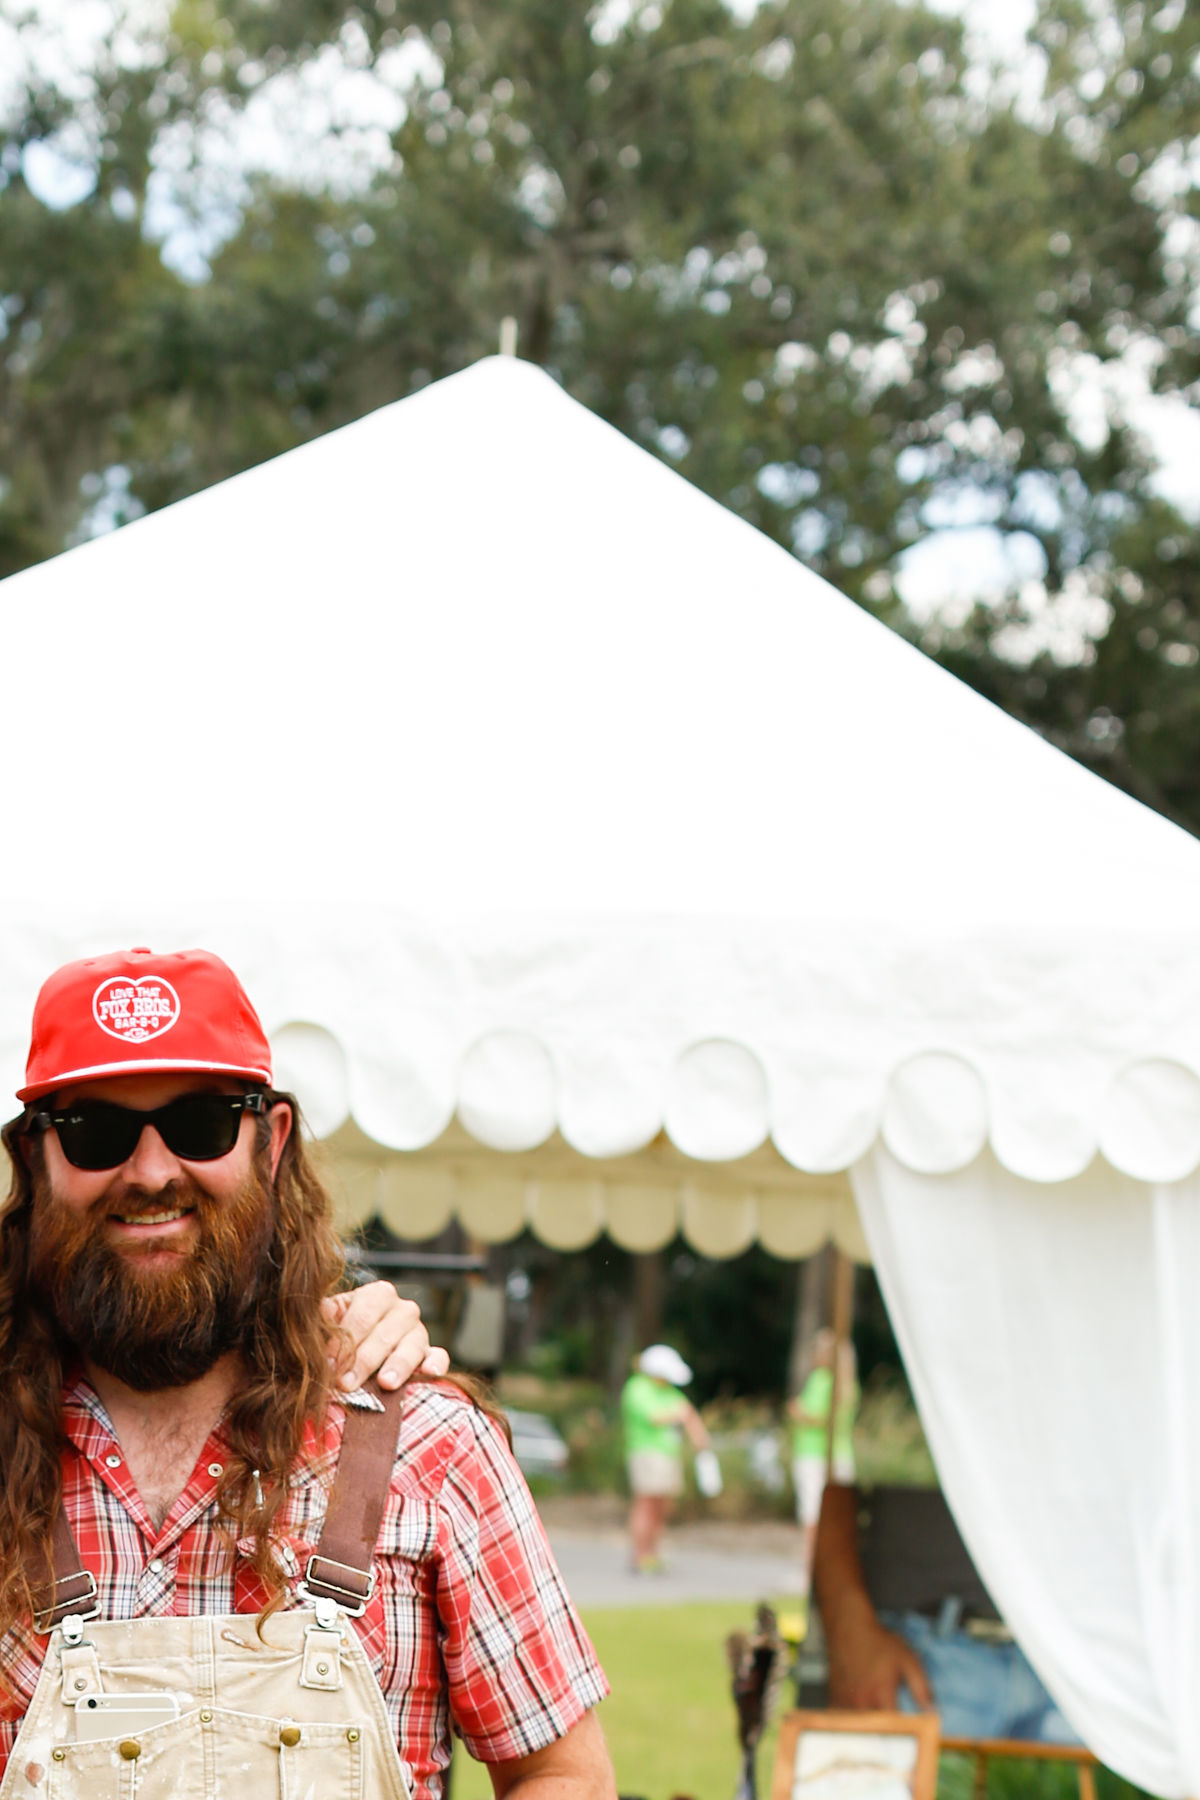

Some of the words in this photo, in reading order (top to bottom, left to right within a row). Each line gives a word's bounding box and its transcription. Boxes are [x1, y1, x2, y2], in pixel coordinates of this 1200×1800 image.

[109, 987, 134, 1000] LOVE
[135, 986, 161, 998] THAT
[99, 998, 131, 1020] FOX
[114, 1016, 159, 1029] BAR-B-Q
